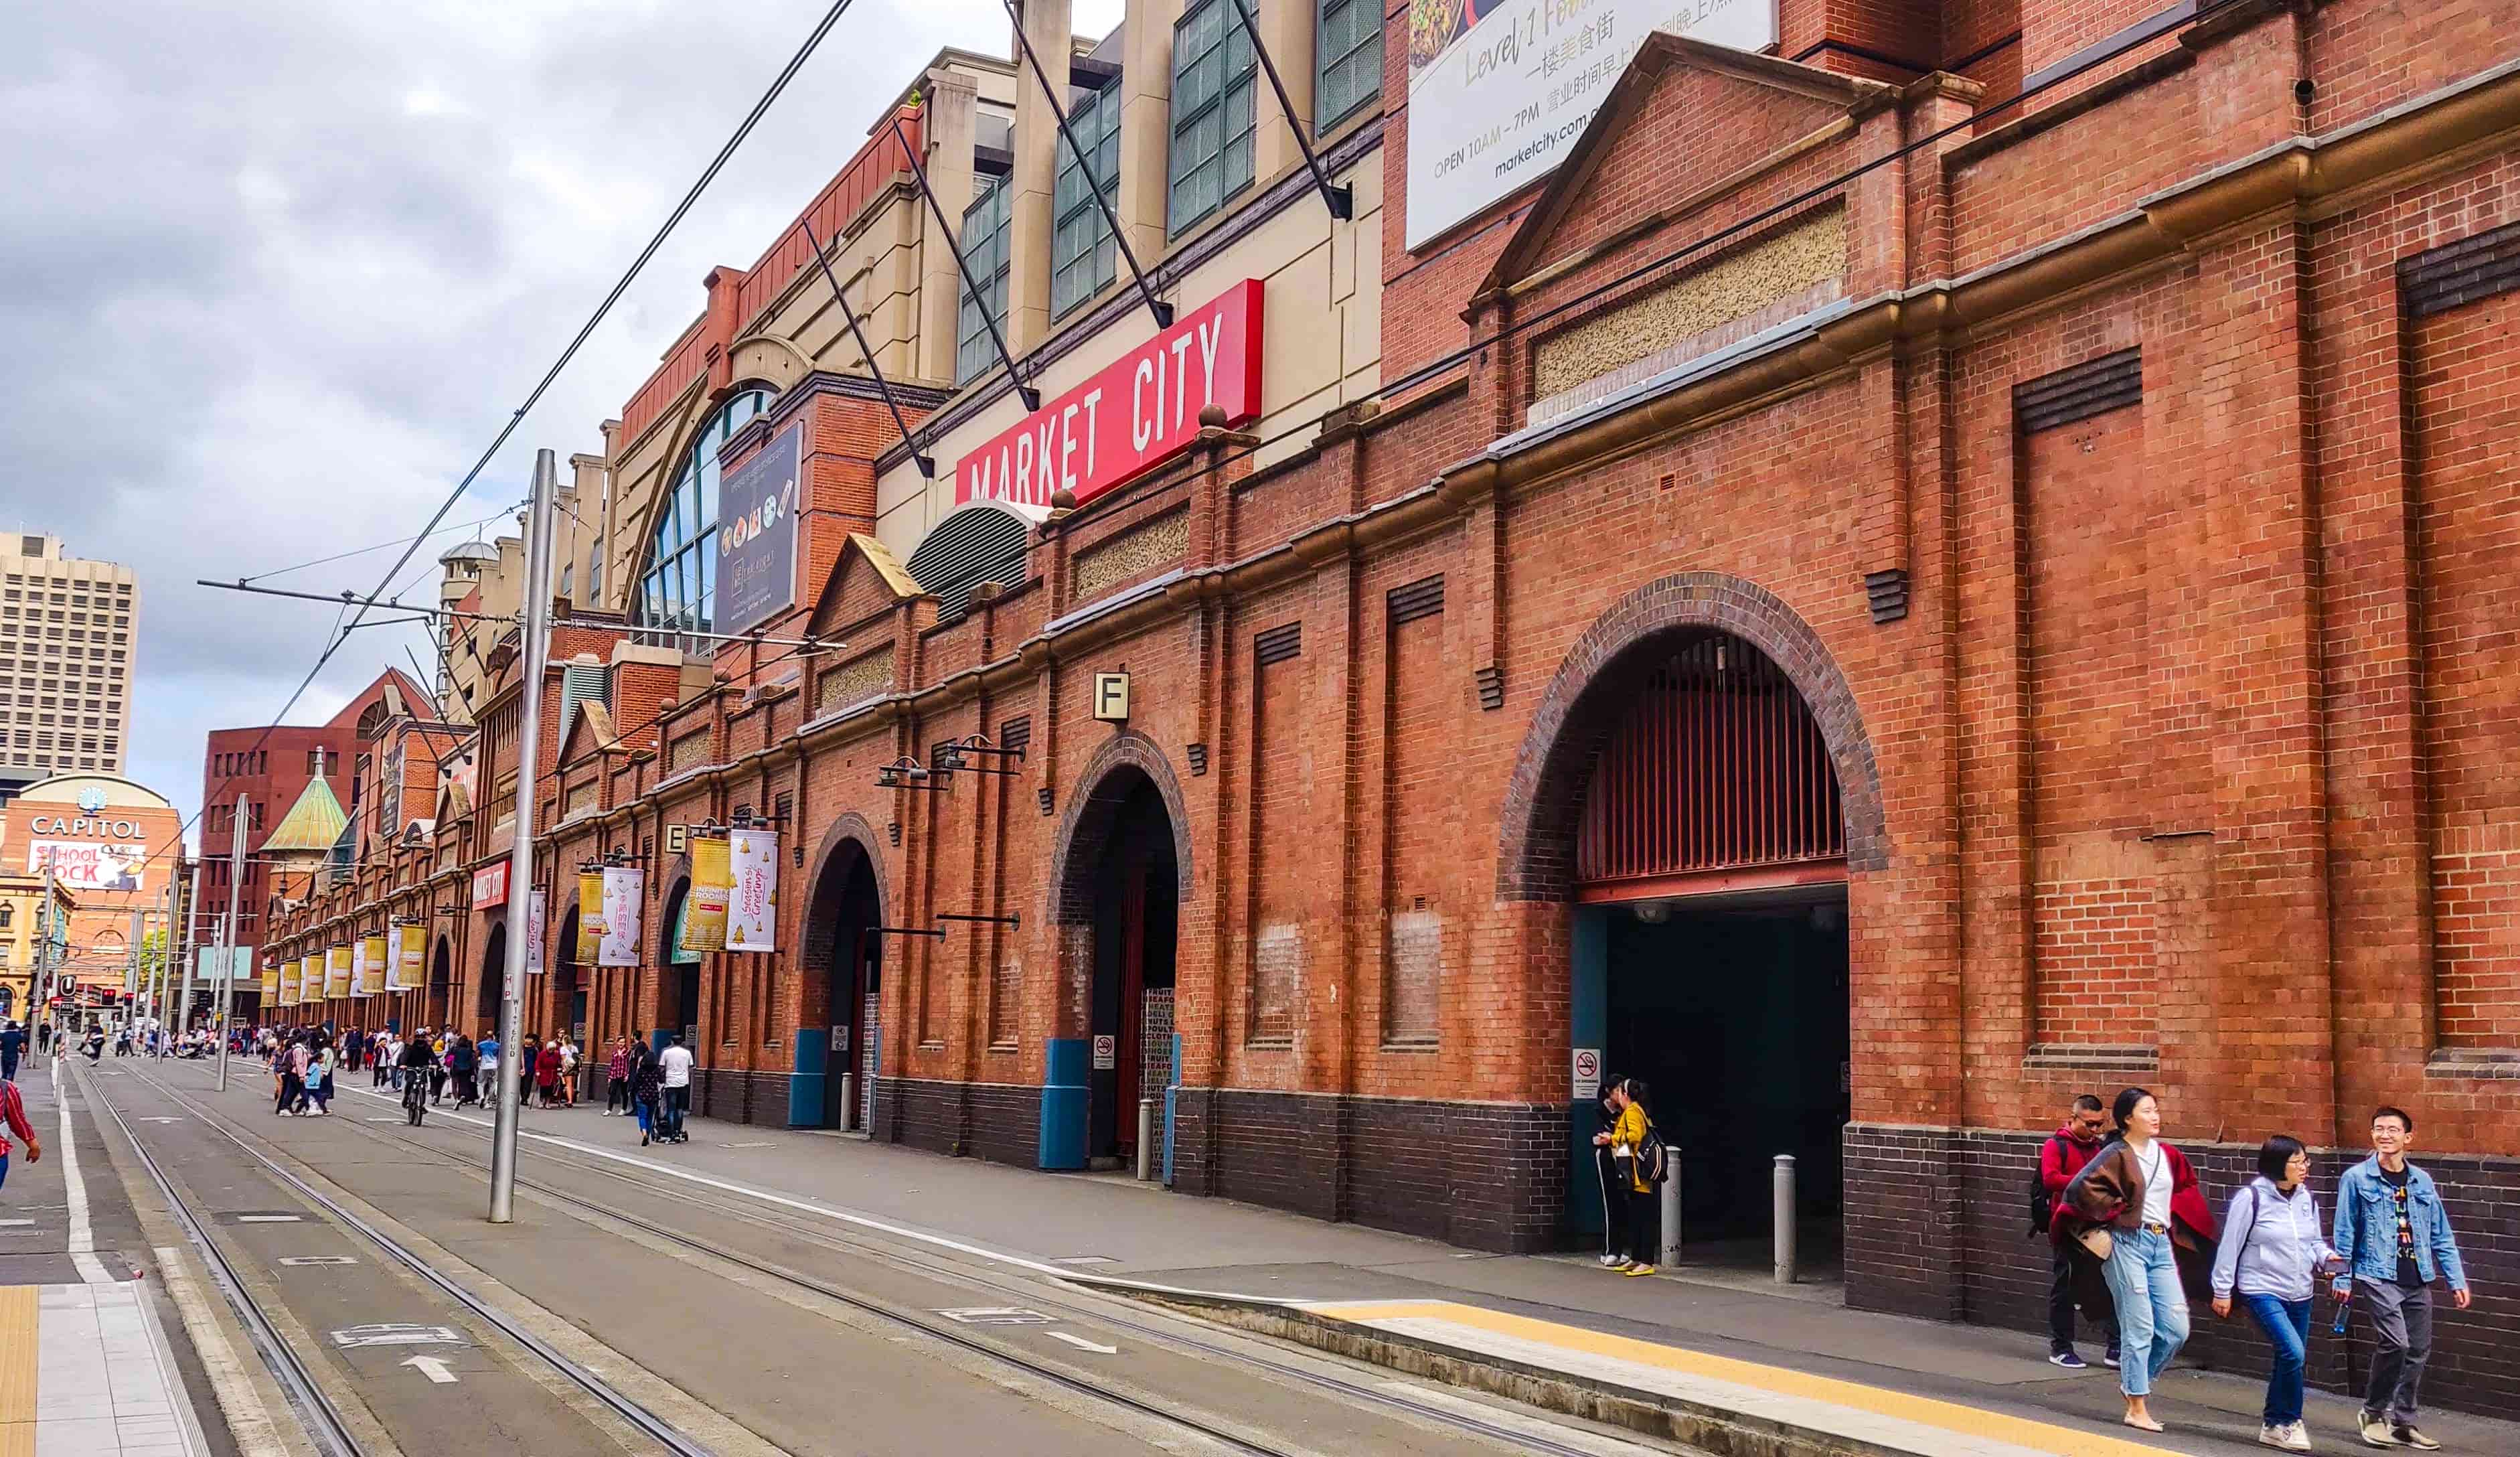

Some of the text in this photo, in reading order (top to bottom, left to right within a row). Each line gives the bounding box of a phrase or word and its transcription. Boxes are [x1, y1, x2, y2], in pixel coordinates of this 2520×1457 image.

[1466, 17, 1522, 87] Level
[1527, 7, 1536, 47] 1
[1525, 9, 1614, 79] 一楼美食街
[1434, 147, 1465, 179] OPEN
[1468, 125, 1501, 159] 10AM
[1514, 101, 1540, 131] 7PM
[971, 312, 1223, 506] MARKET CITY
[1101, 678, 1121, 714] F
[31, 816, 147, 840] CAPITOL
[670, 827, 683, 849] E
[36, 846, 101, 862] SHOOL
[38, 862, 100, 883] OCK
[696, 892, 729, 901] ROOMS
